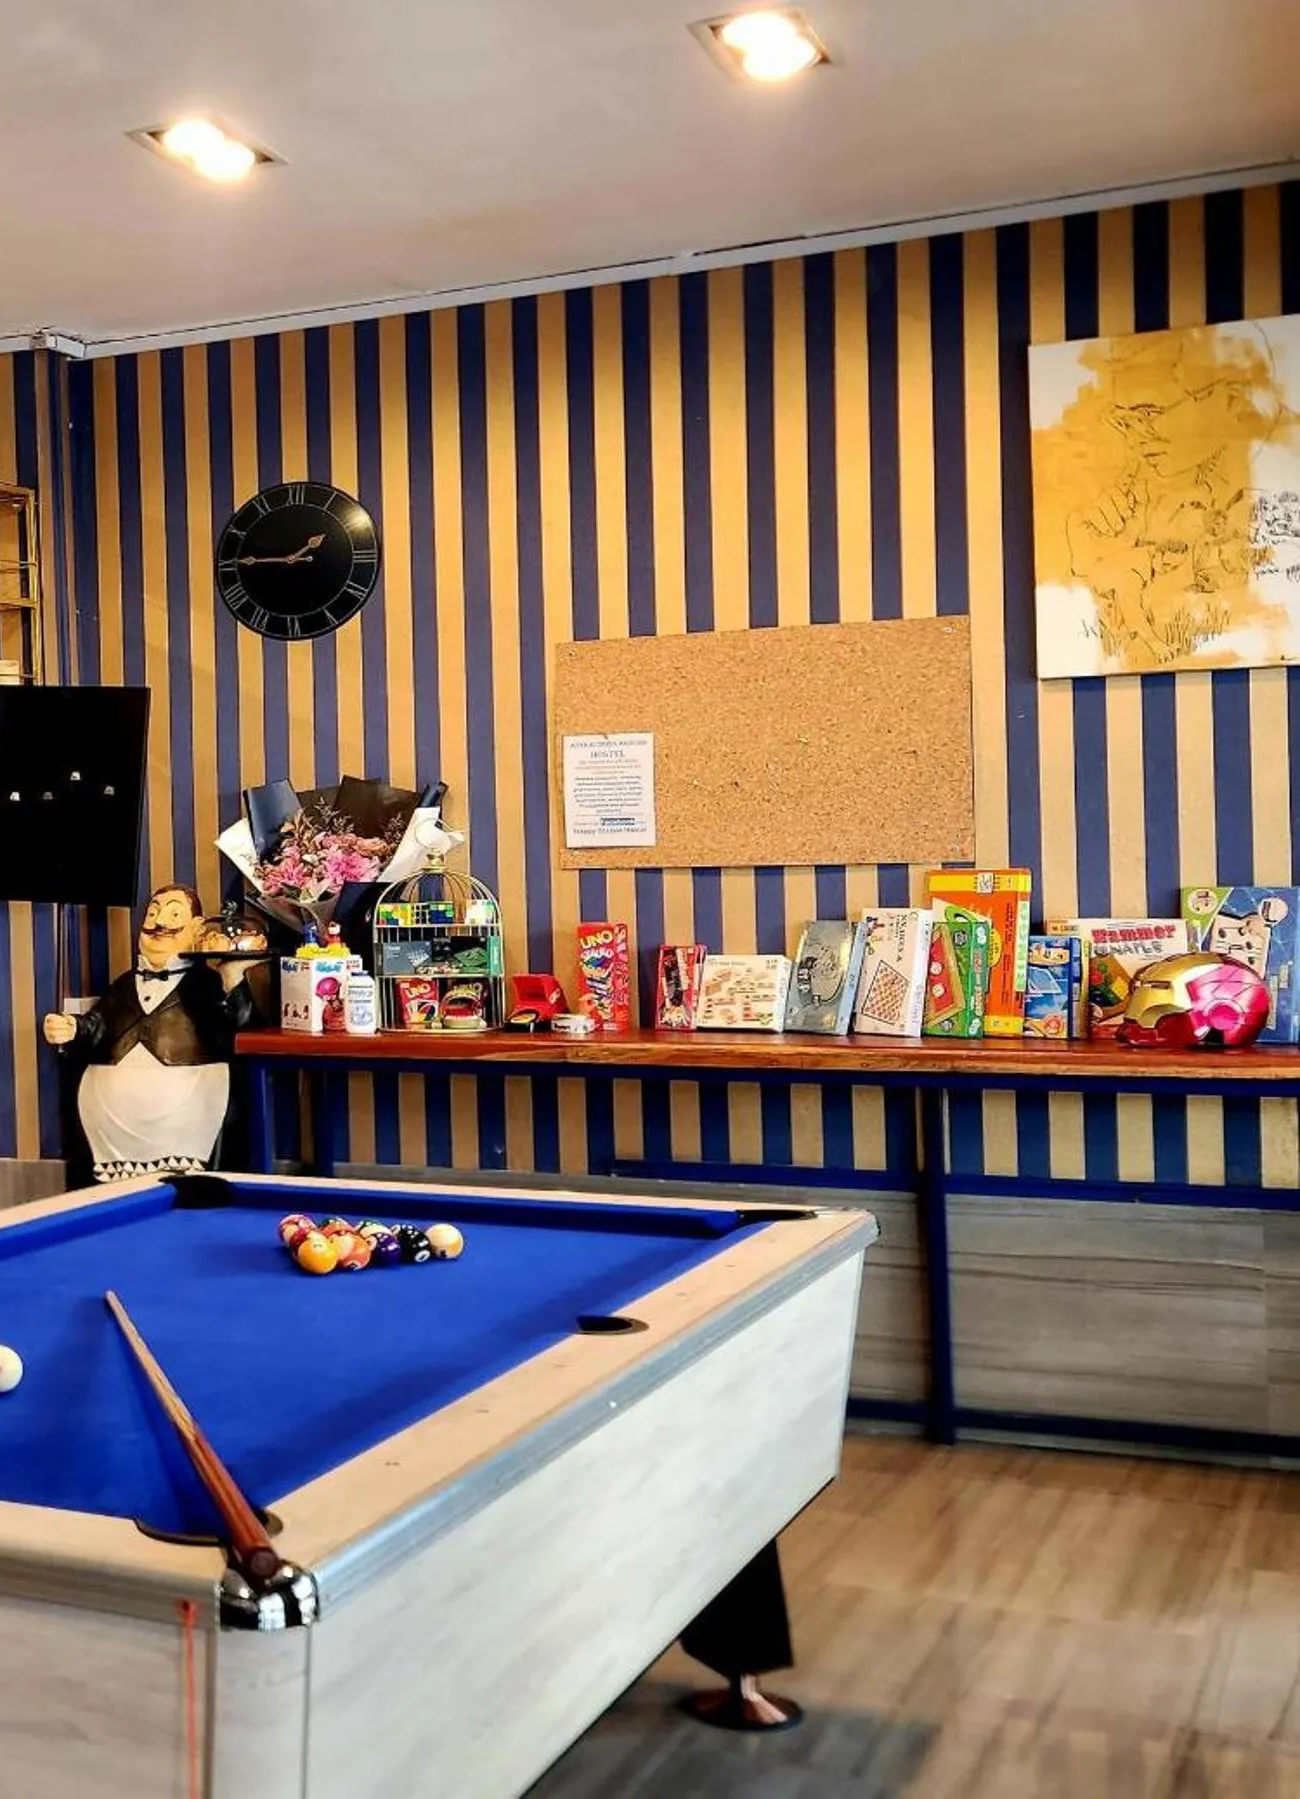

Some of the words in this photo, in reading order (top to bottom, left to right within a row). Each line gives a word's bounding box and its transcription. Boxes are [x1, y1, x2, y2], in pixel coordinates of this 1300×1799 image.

[580, 930, 613, 949] UNO
[1091, 925, 1176, 943] Hammer
[406, 983, 431, 998] UNO
